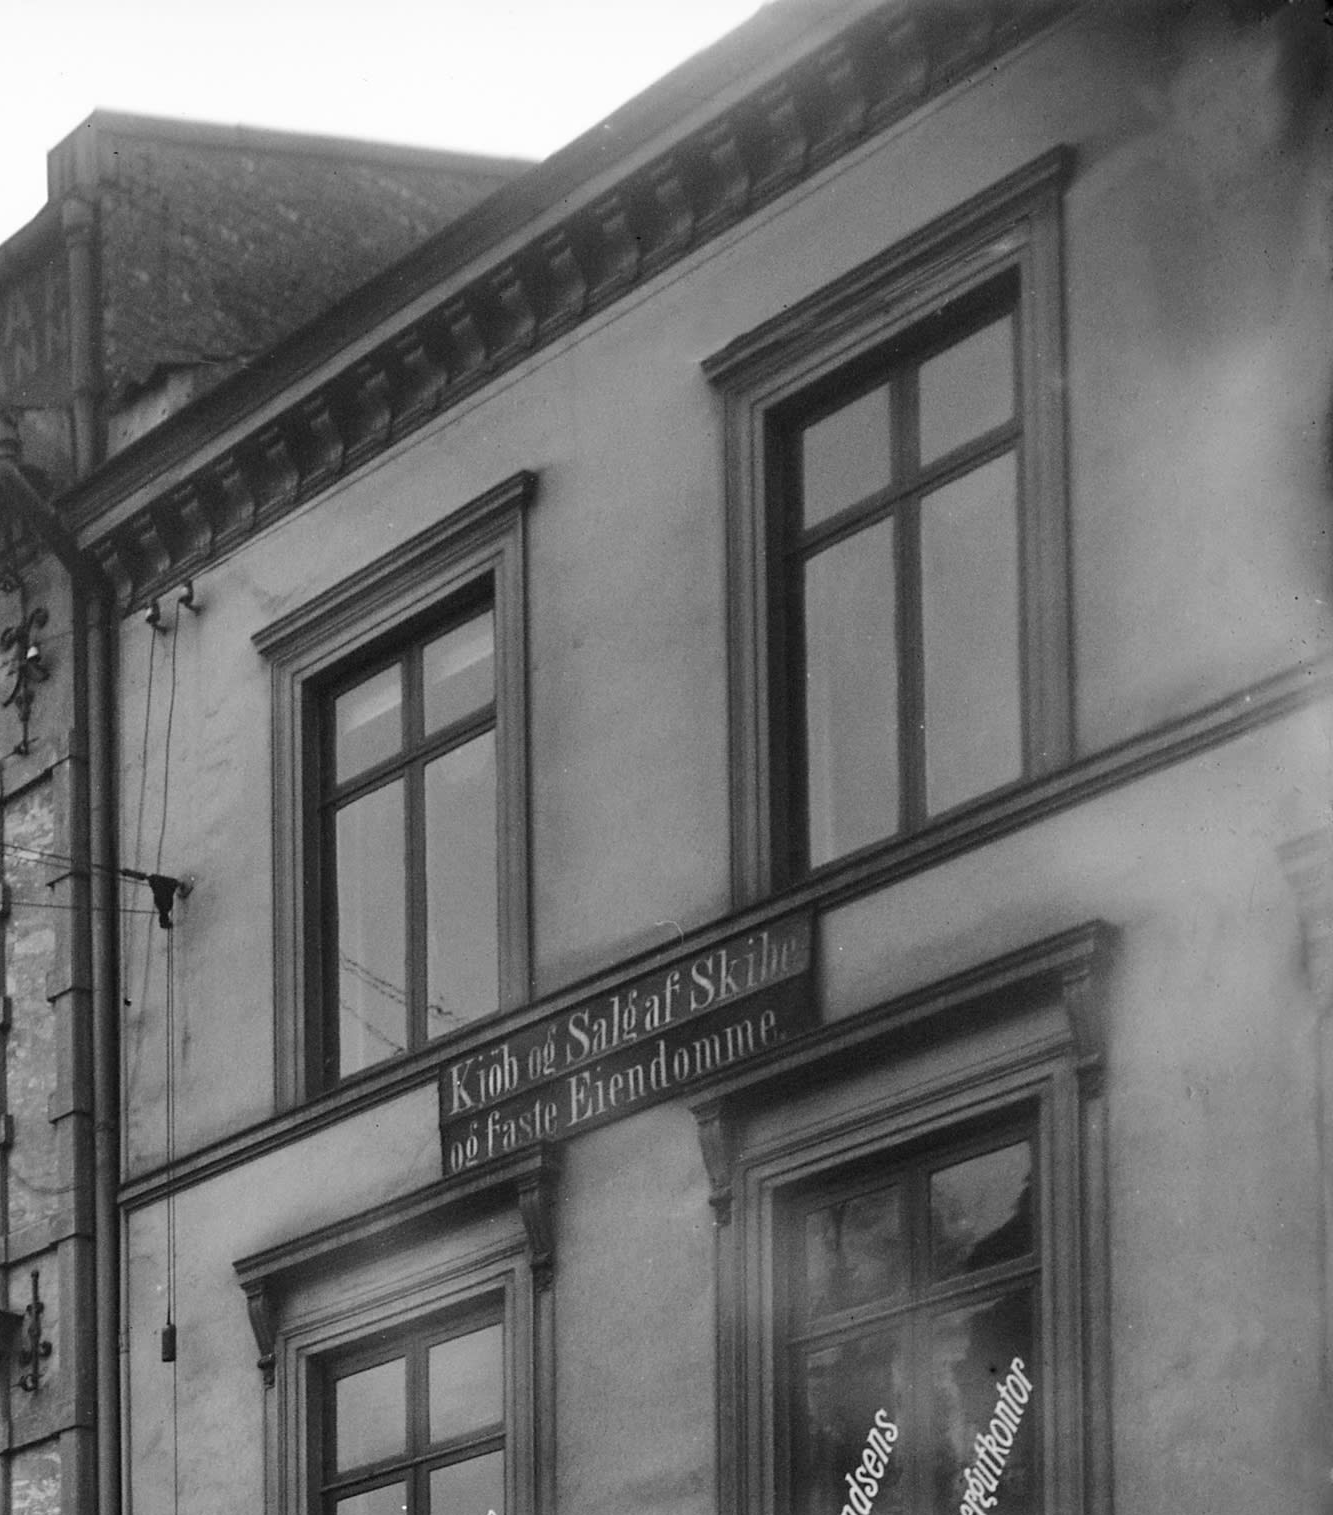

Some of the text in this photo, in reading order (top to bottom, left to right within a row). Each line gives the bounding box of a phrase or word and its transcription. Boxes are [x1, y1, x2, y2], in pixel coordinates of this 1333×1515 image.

[528, 1024, 556, 1079] og
[566, 990, 638, 1065] Salg
[644, 970, 680, 1032] af
[450, 1123, 479, 1172] og
[487, 1100, 558, 1160] faste
